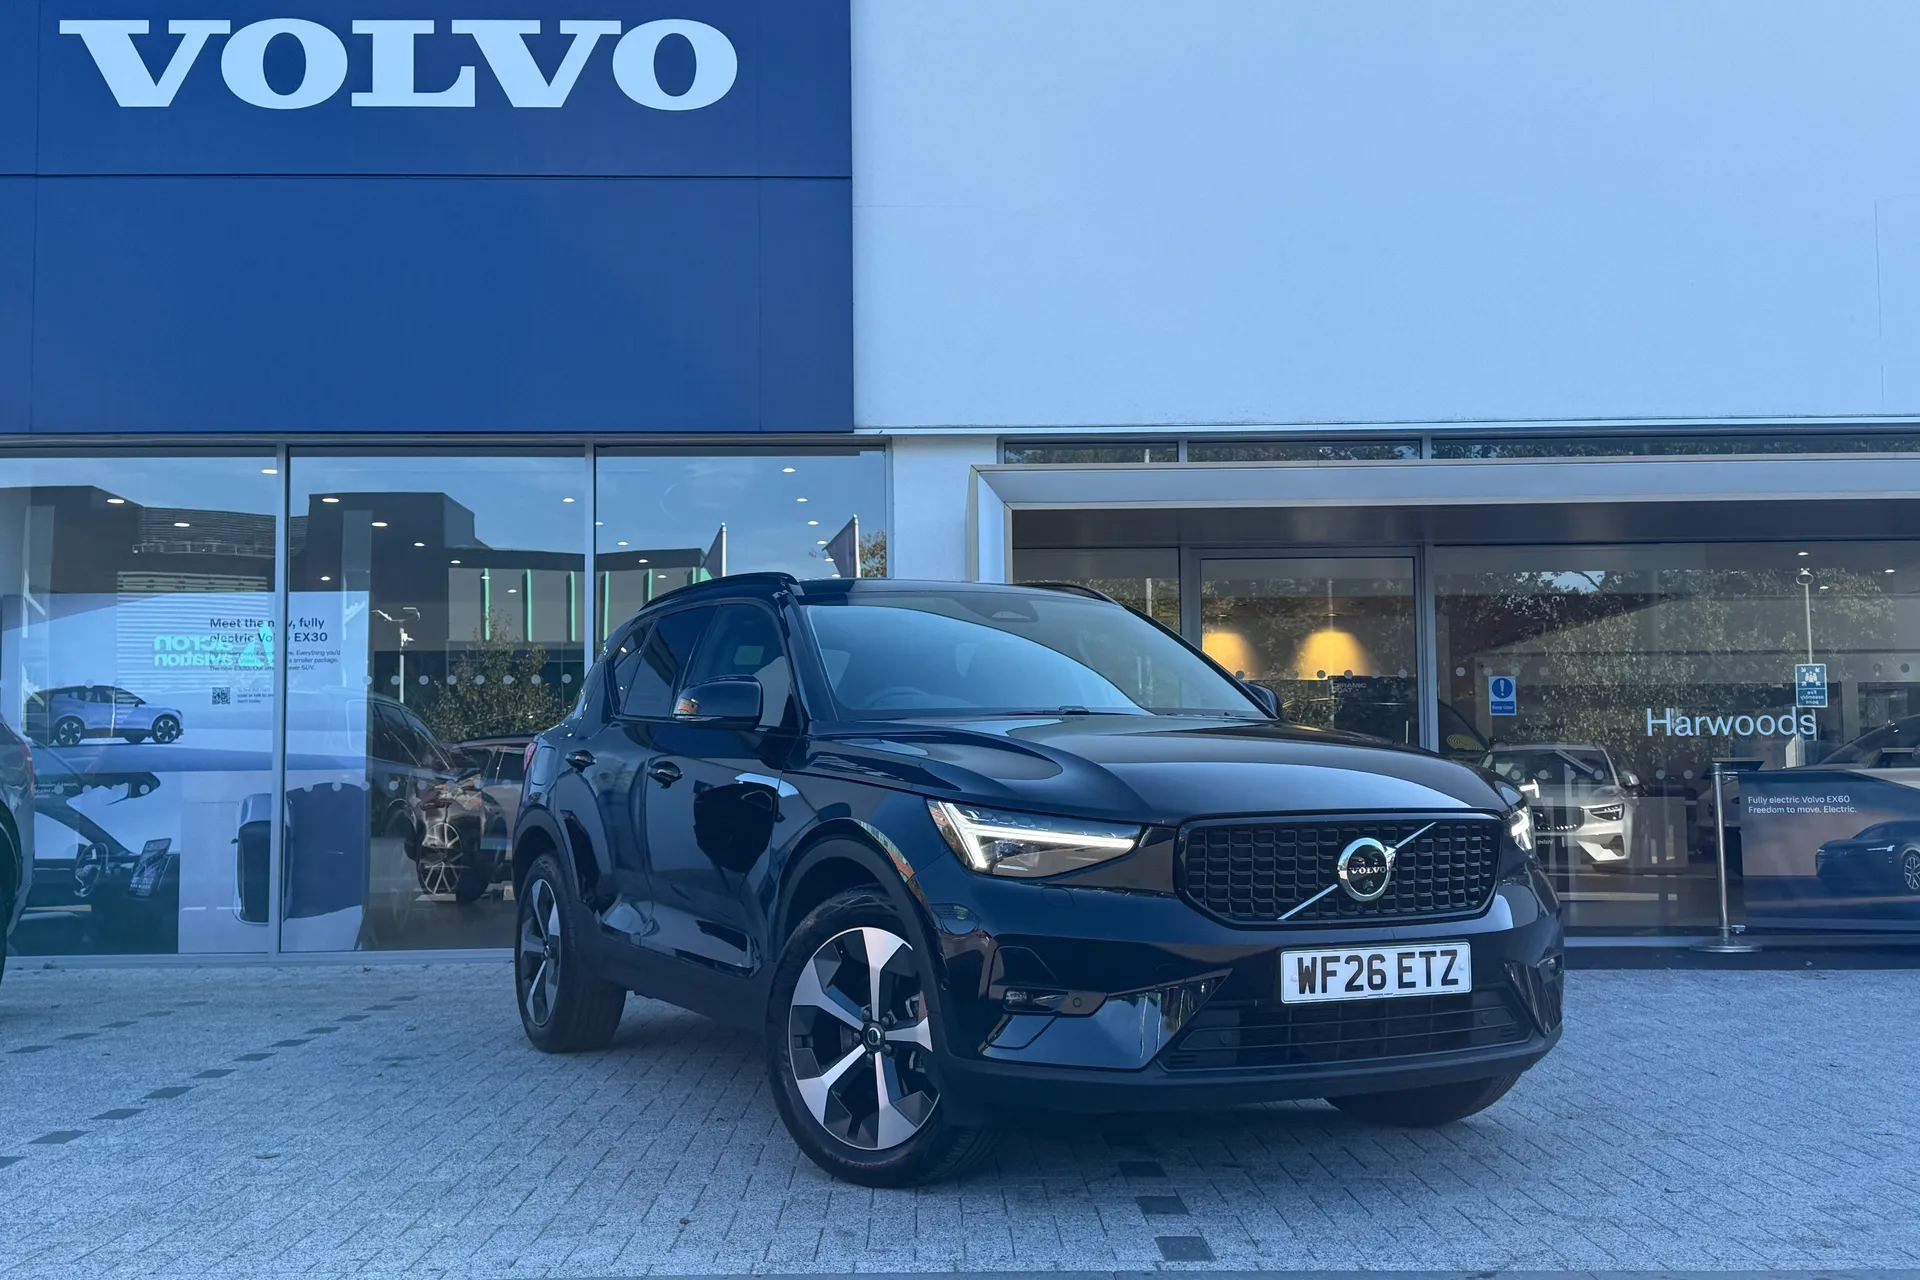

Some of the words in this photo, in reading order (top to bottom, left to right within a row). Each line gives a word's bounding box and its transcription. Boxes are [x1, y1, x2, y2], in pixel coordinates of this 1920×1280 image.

[59, 18, 739, 111] VOLVO
[210, 618, 240, 628] Meet
[244, 618, 264, 628] the
[299, 617, 325, 629] fully
[210, 633, 254, 643] electric
[294, 632, 328, 642] EX30
[1647, 706, 1817, 737] Harwoods
[1748, 796, 1767, 805] Fully
[1769, 796, 1800, 804] electric
[1827, 795, 1850, 803] EX60
[1748, 806, 1784, 814] Freedom
[1350, 866, 1386, 875] VOLVO
[1297, 954, 1387, 995] WF26
[1397, 949, 1459, 989] ETZ
